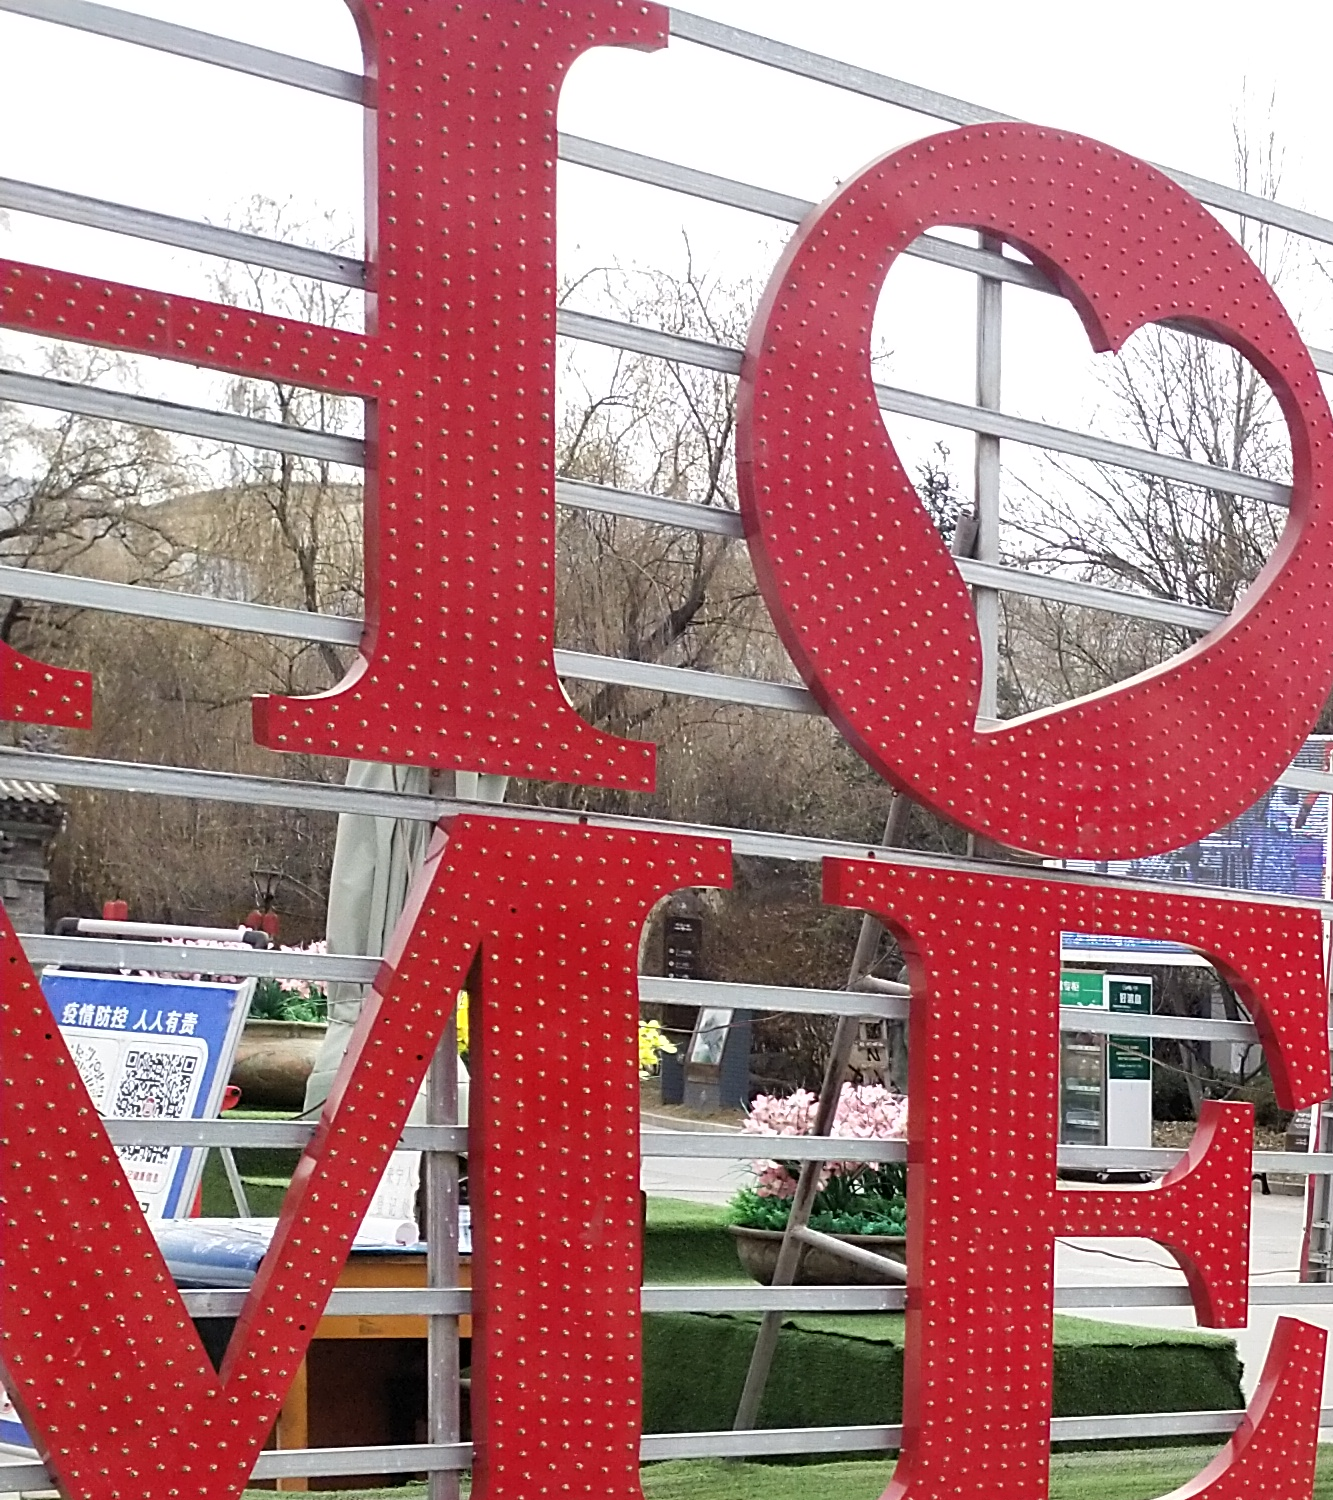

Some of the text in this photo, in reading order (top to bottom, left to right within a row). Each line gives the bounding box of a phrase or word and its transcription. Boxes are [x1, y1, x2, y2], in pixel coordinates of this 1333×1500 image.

[61, 1002, 199, 1035] 疫情防控 人人有责
